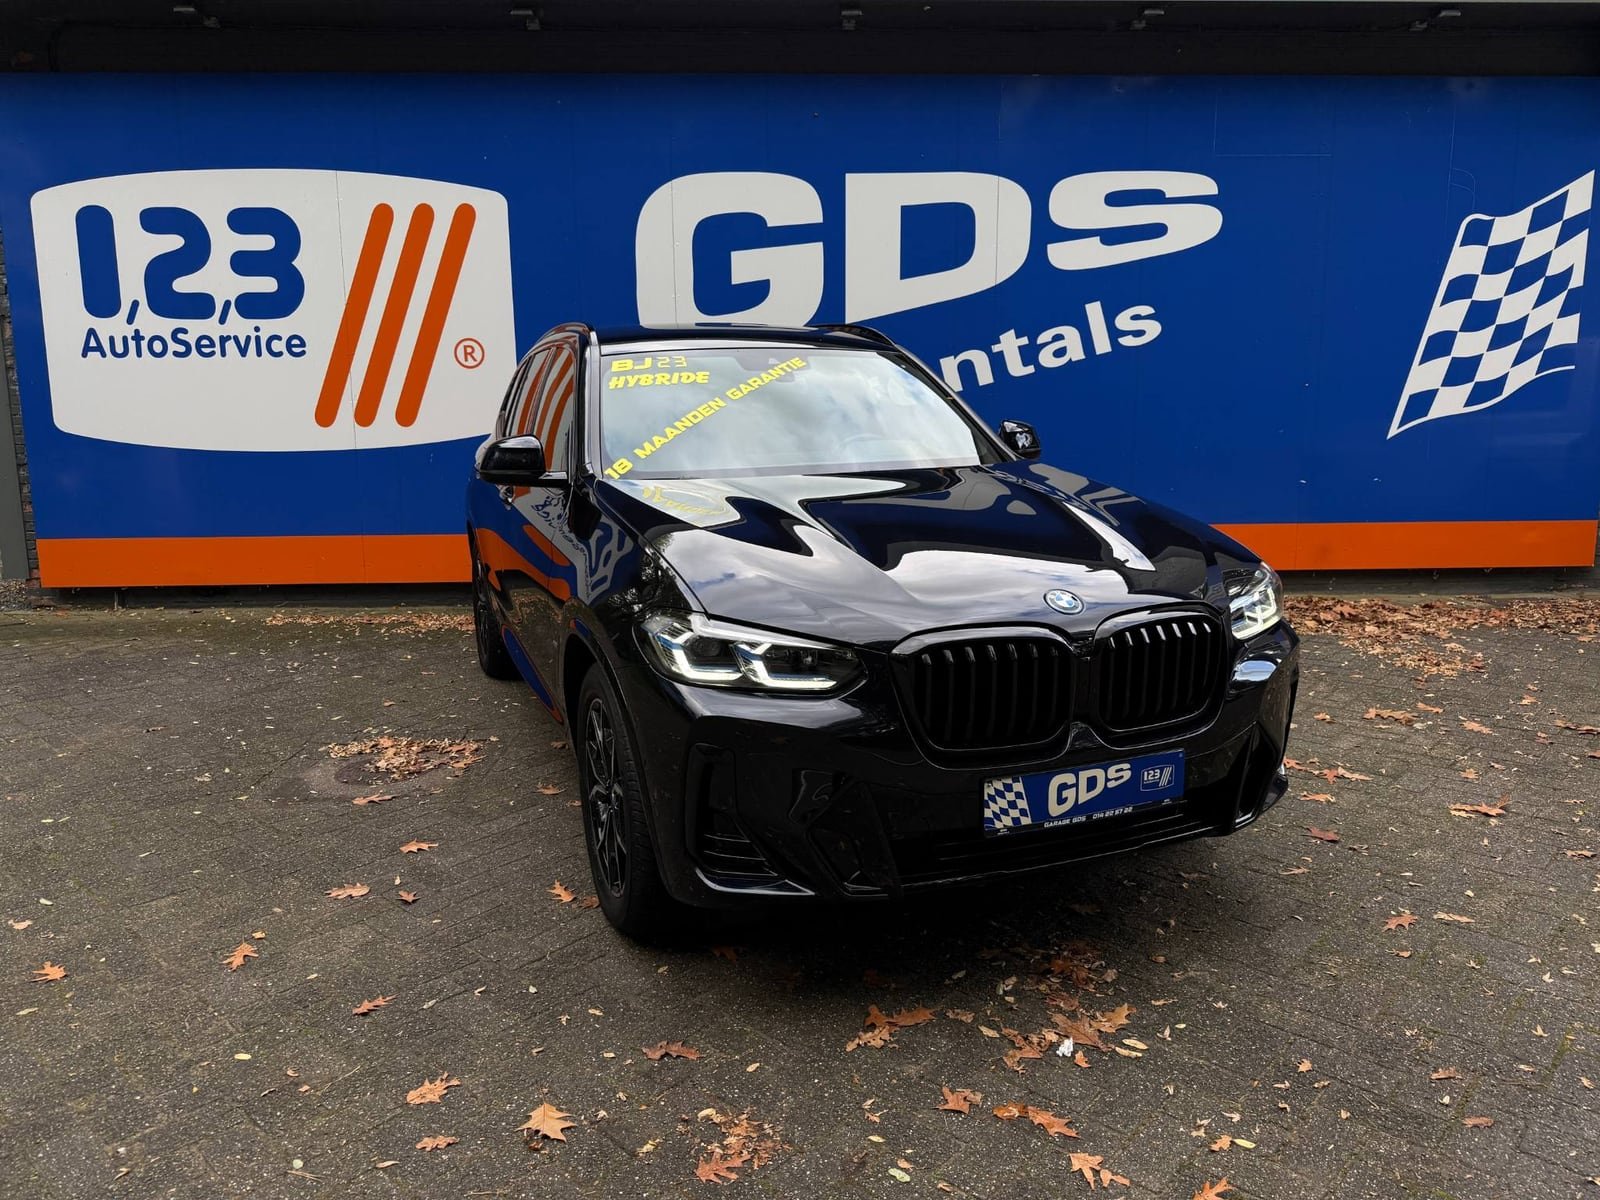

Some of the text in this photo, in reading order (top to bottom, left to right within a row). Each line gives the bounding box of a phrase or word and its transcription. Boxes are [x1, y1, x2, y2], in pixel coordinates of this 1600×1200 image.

[635, 170, 1223, 329] GDS
[82, 325, 307, 359] AutoService
[940, 301, 1162, 392] ntals
[608, 371, 710, 389] HYBRIDE
[611, 355, 688, 372] BJ 23
[604, 357, 807, 480] 18 MAANDEN GARANTIE
[1047, 763, 1132, 817] GDS
[1143, 769, 1161, 781] 123
[1043, 818, 1071, 828] GARAGE
[1072, 815, 1087, 824] GDS
